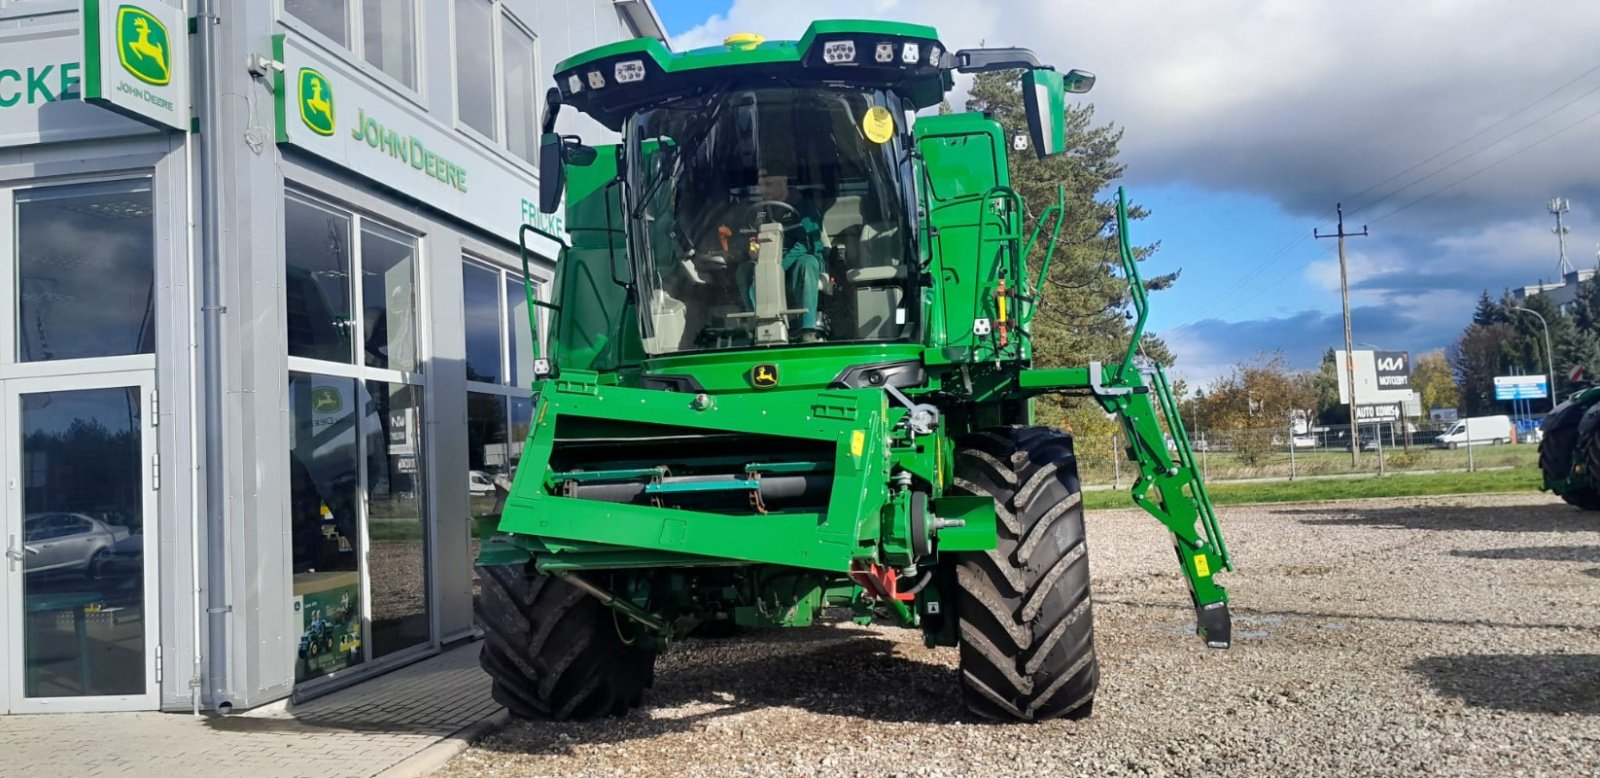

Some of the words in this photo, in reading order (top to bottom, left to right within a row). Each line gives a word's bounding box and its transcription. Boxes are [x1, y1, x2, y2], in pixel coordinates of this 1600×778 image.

[116, 80, 143, 99] JOHN
[144, 90, 173, 112] DEERE
[351, 107, 407, 163] JOHN
[409, 135, 467, 193] DEERE
[521, 198, 563, 238] FRICKE
[1377, 357, 1404, 371] KIA
[1356, 406, 1374, 418] AUTO
[1375, 405, 1395, 416] KOMIS
